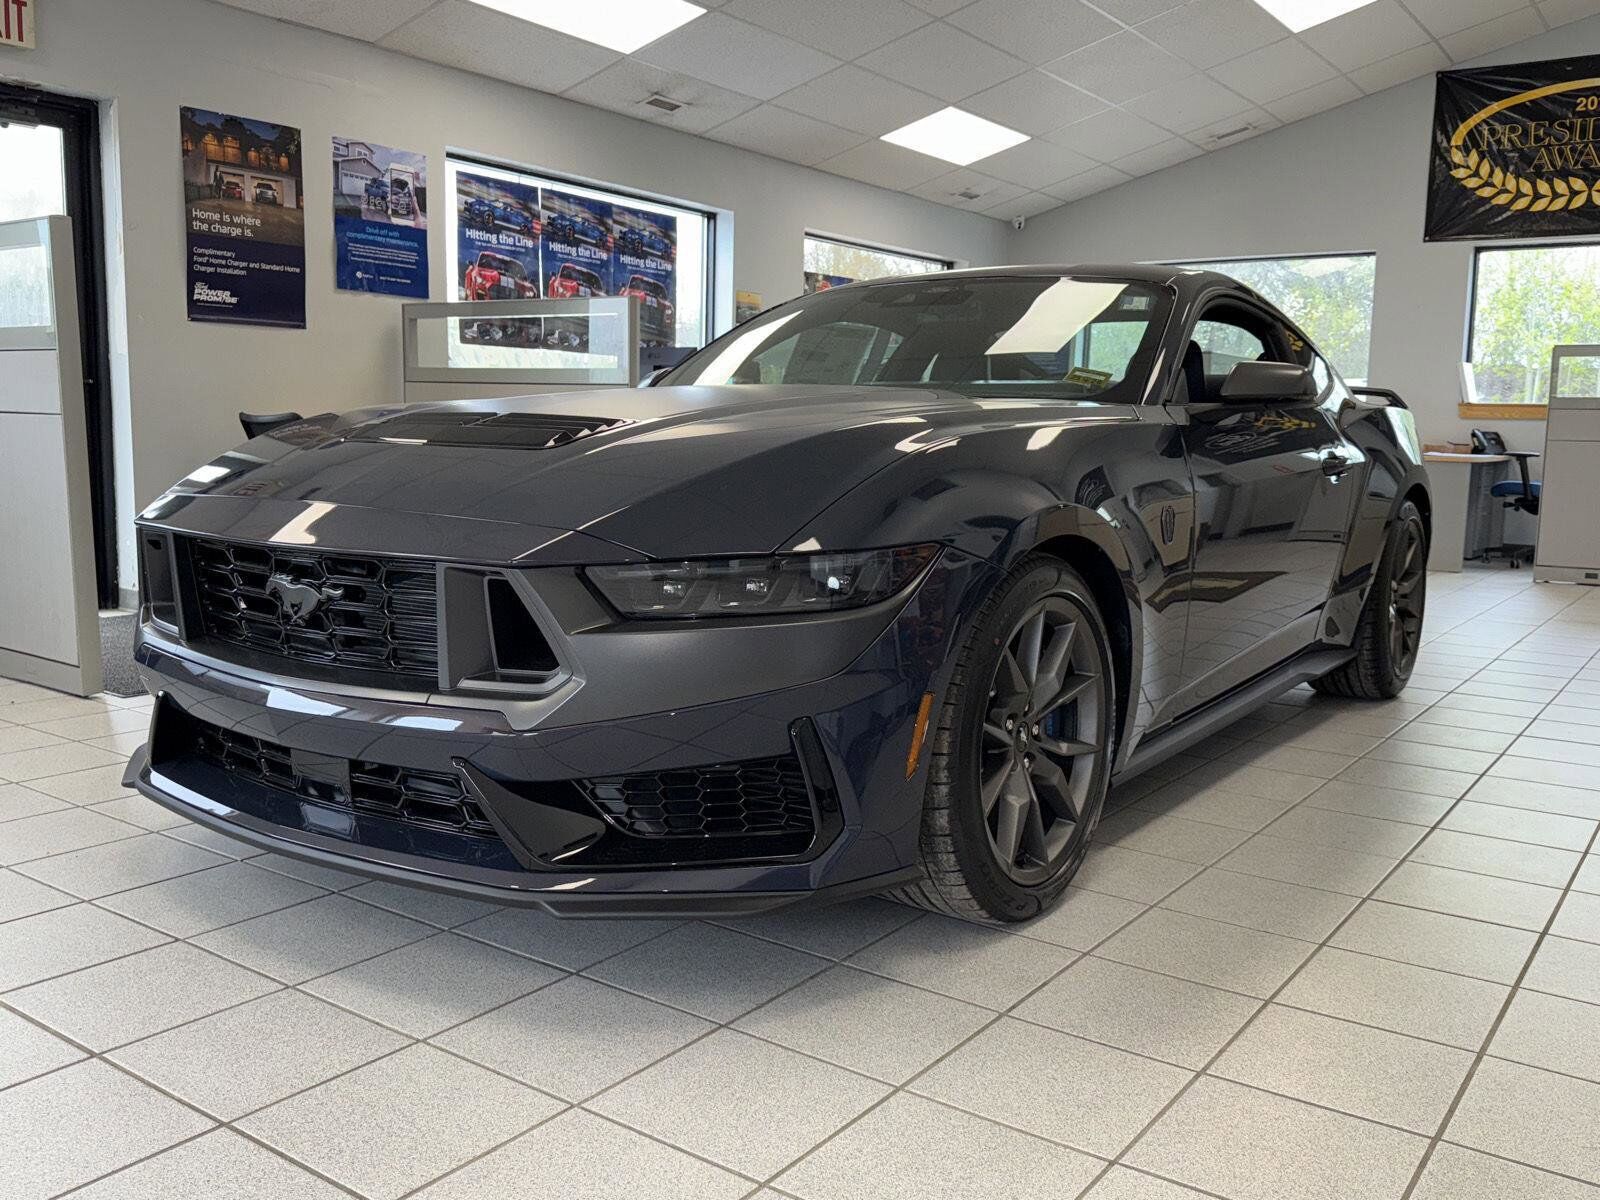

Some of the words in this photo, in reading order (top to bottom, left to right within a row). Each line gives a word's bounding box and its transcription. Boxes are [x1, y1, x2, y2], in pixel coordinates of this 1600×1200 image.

[0, 0, 28, 42] IT
[1575, 95, 1600, 112] 20
[192, 208, 221, 221] Home
[222, 212, 231, 222] is
[232, 214, 261, 226] where
[192, 220, 209, 231] the
[210, 223, 242, 237] charge
[244, 227, 254, 237] is.
[366, 226, 379, 234] Drive
[465, 228, 498, 244] Hitting
[499, 233, 514, 245] the
[515, 236, 534, 248] Line
[193, 246, 236, 258] Complimentary
[548, 241, 577, 256] Hitting
[578, 246, 590, 257] the
[591, 248, 608, 260] Line
[193, 264, 216, 273] Charger
[217, 267, 247, 276] Installation
[209, 257, 226, 265] Home
[227, 259, 248, 268] Charger
[261, 263, 284, 272] Standard
[620, 255, 645, 268] Hitting
[645, 259, 657, 269] the
[657, 260, 673, 271] Line
[194, 289, 231, 297] POWER
